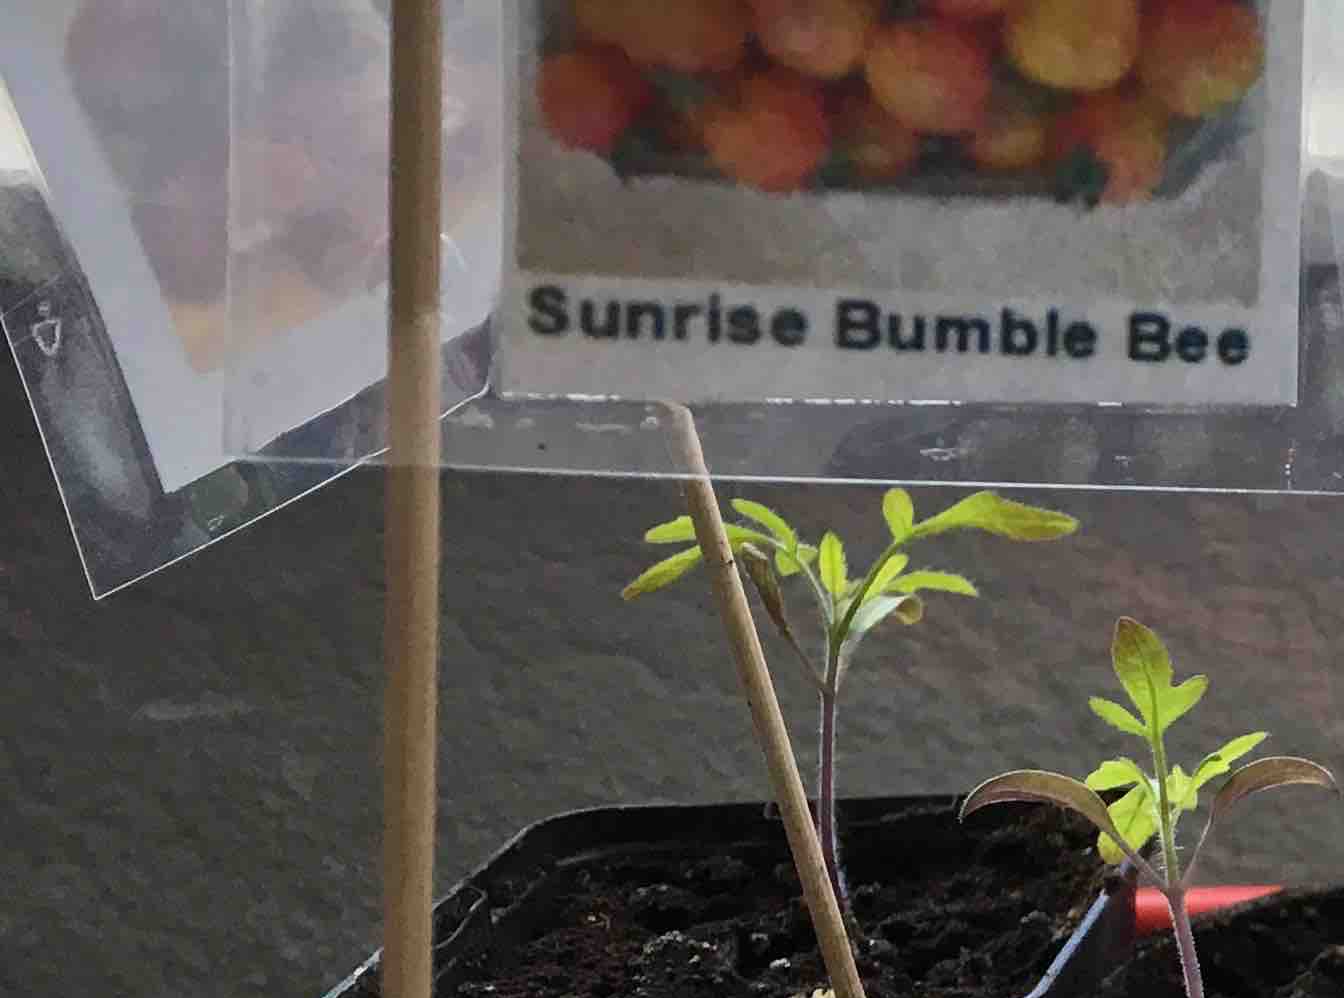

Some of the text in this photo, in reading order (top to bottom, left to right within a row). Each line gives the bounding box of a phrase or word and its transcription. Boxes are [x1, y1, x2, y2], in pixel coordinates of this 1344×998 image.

[525, 283, 1251, 367] Sunrise Bumble Bee
